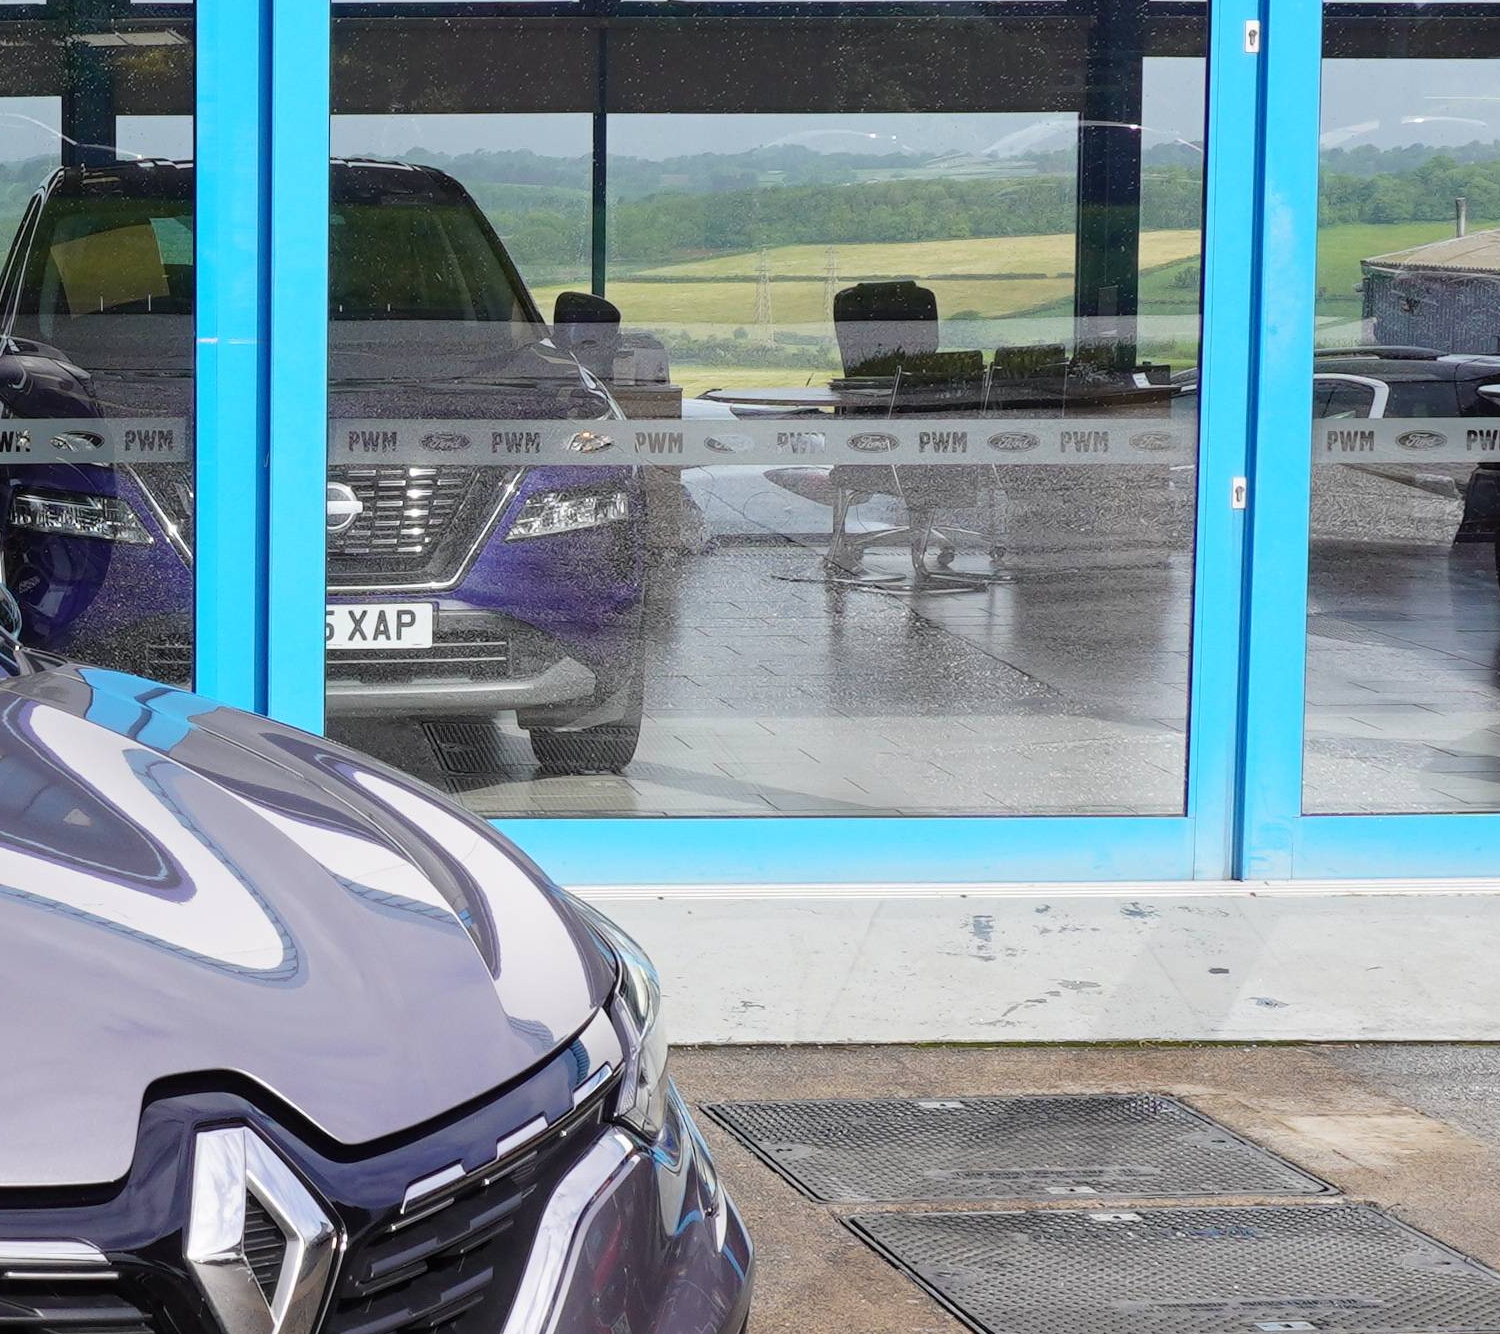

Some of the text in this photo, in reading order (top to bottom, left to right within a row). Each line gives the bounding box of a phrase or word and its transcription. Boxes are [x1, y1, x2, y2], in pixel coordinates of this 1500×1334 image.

[124, 429, 174, 452] PWM
[348, 431, 398, 452] PWM
[491, 431, 541, 453] PWM
[634, 432, 684, 454] PWM
[919, 431, 968, 453] PWM
[1060, 431, 1109, 453] PWM
[1327, 430, 1375, 452] PWM
[347, 609, 417, 642] XAP
